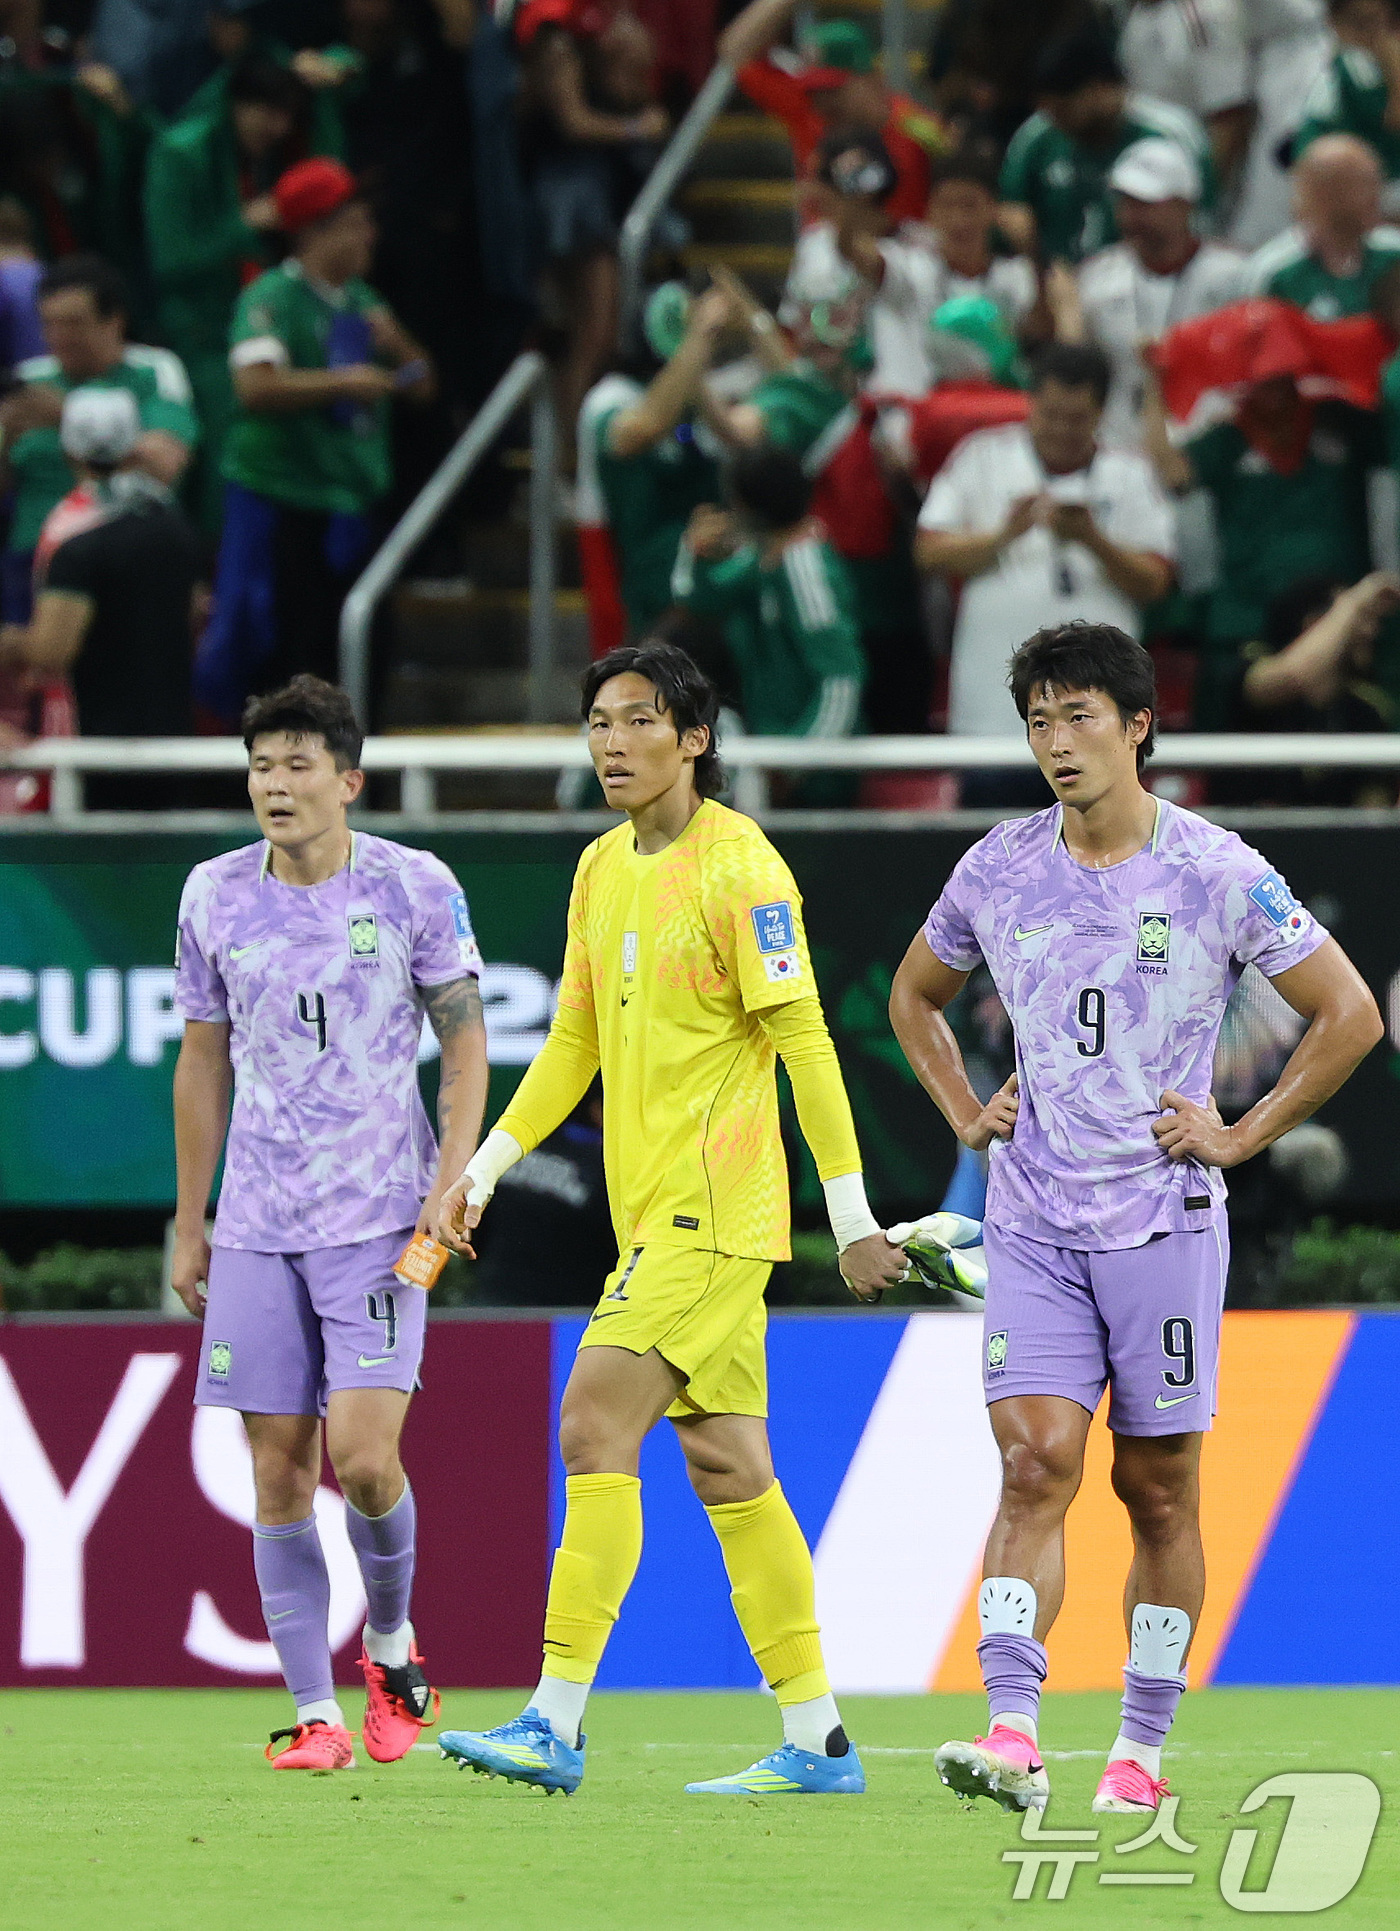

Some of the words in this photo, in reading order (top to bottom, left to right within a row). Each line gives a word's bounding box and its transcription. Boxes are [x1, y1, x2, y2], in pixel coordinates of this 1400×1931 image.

[1136, 965, 1168, 975] KOREA
[296, 990, 327, 1053] 4
[1076, 987, 1107, 1058] 9
[363, 1290, 398, 1351] 4
[1160, 1316, 1195, 1388] 9
